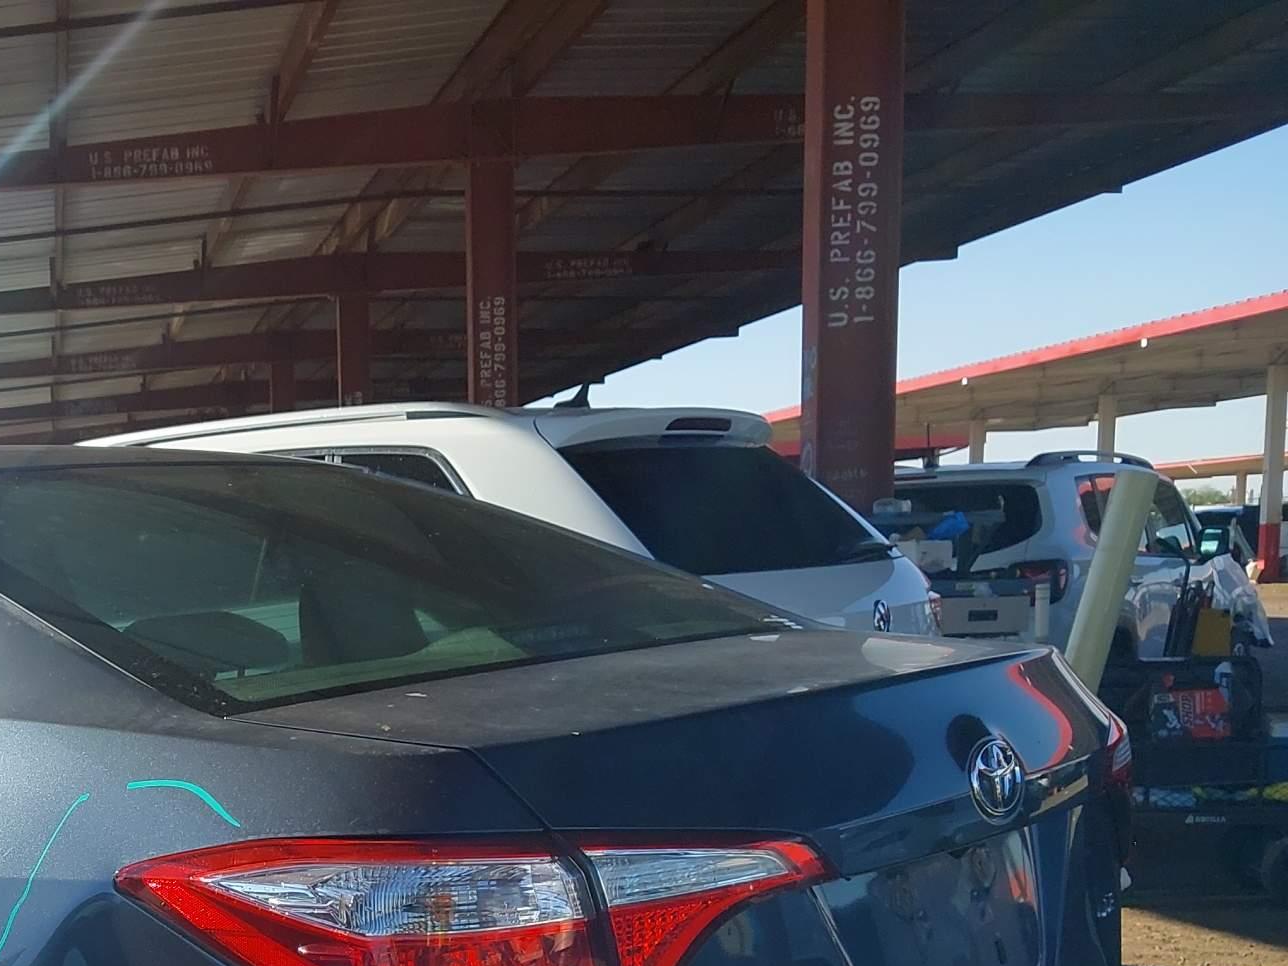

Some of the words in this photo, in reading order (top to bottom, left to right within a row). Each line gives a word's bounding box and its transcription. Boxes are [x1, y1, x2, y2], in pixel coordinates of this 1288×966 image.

[123, 146, 180, 164] PREFAB
[830, 160, 854, 263] PREFAB
[853, 95, 882, 323] 1-866-799-0969
[479, 331, 492, 388] PREFAB
